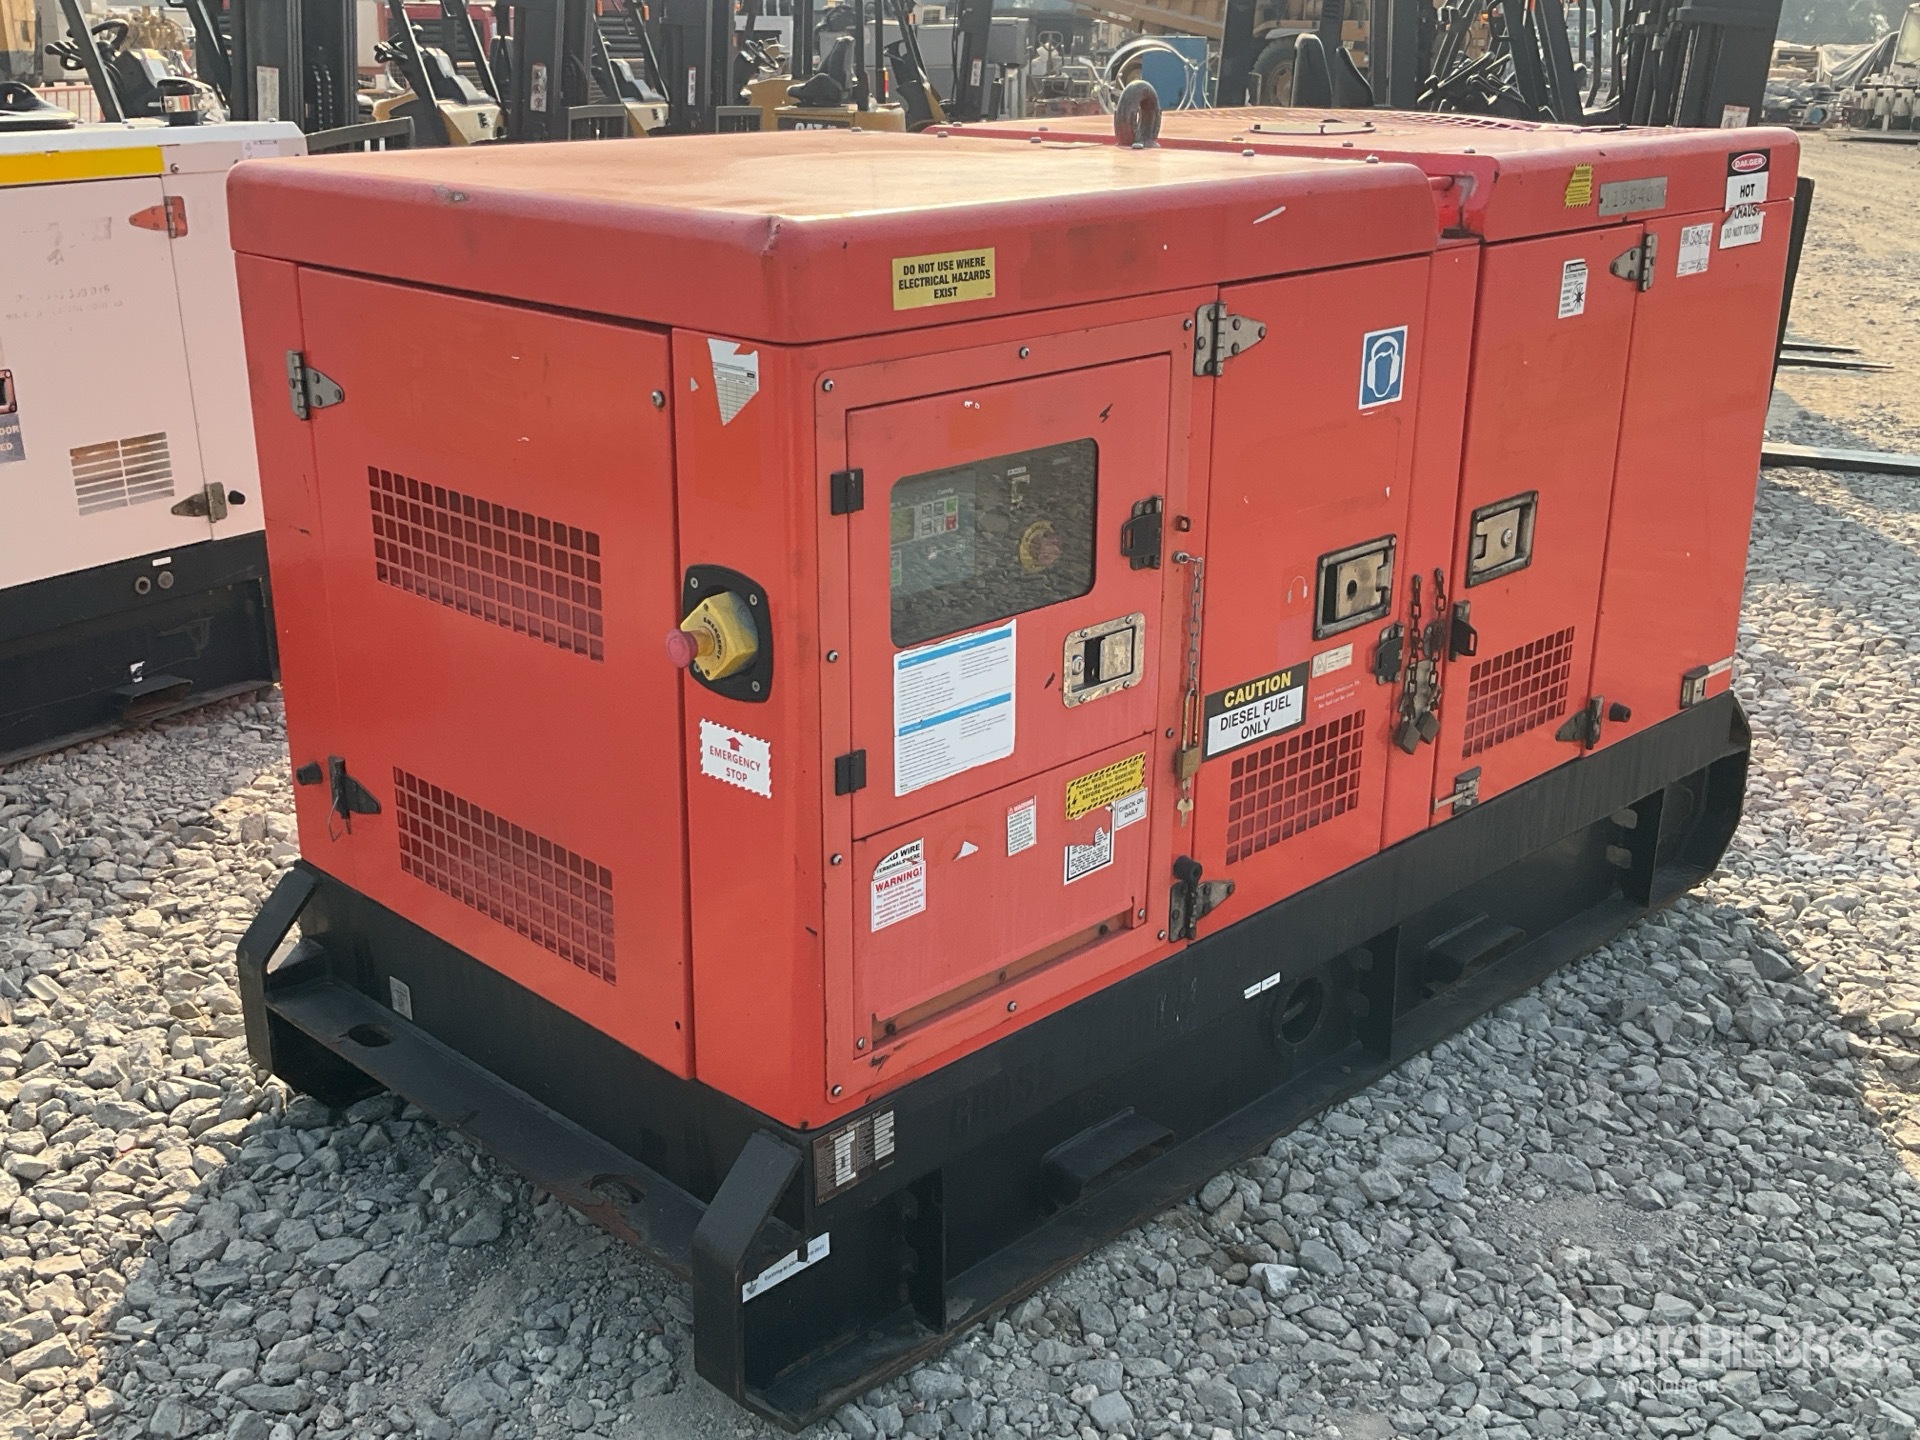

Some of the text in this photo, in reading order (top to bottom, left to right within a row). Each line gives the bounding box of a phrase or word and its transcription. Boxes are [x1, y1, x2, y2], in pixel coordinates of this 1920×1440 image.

[1740, 184, 1756, 198] HOT
[1724, 227, 1731, 239] DO
[1733, 224, 1742, 236] NOT
[1744, 223, 1760, 235] TOUCH
[903, 256, 986, 276] DO NOT USE WHERE
[898, 270, 991, 290] ELECTRICAL HAZARDS
[933, 286, 958, 299] EXIST
[703, 616, 722, 660] EMERGENCY
[1224, 671, 1292, 708] CAUTION
[1220, 695, 1292, 732] DIESEL FUEL
[1241, 717, 1270, 740] ONLY
[710, 745, 760, 772] EMERGENCY
[726, 767, 748, 782] STOP
[1082, 788, 1100, 800] BEFORE
[1118, 797, 1144, 813] CHECK OIL
[1124, 808, 1138, 818] DAILY
[900, 844, 920, 857] WIRE
[876, 860, 906, 874] TERMINALS
[875, 867, 922, 892] WARNING!
